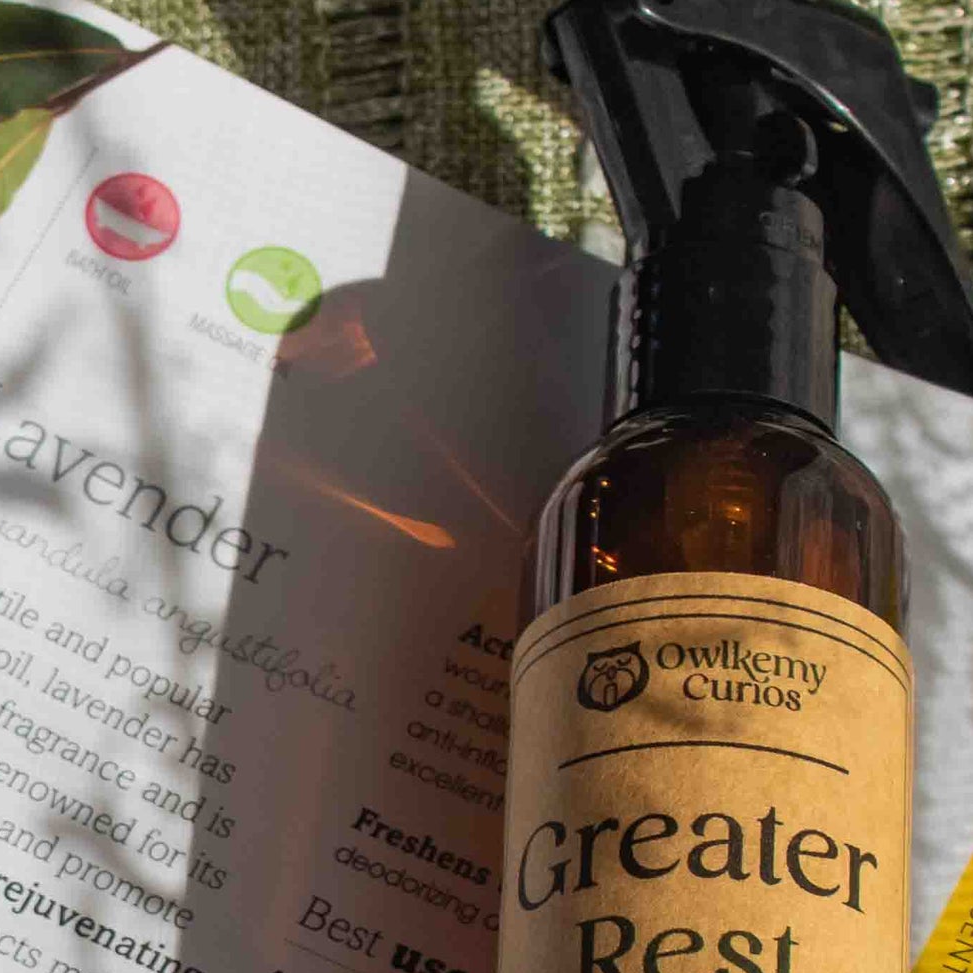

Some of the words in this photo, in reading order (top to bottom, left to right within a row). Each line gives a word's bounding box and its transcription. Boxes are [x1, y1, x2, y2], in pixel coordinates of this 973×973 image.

[45, 621, 109, 664] and
[105, 653, 232, 725] popular
[143, 593, 356, 712] angustifolia
[656, 640, 827, 695] Owlkemy
[42, 667, 178, 753] lavender
[179, 737, 236, 785] has
[682, 674, 802, 712] Curios
[142, 781, 207, 824] and
[206, 806, 236, 839] is
[351, 806, 492, 887] Freshens
[54, 851, 196, 931] promote
[137, 828, 186, 869] for
[188, 851, 229, 891] its
[333, 844, 480, 925] deodorizing
[517, 806, 878, 914] Greater
[298, 894, 384, 958] Best
